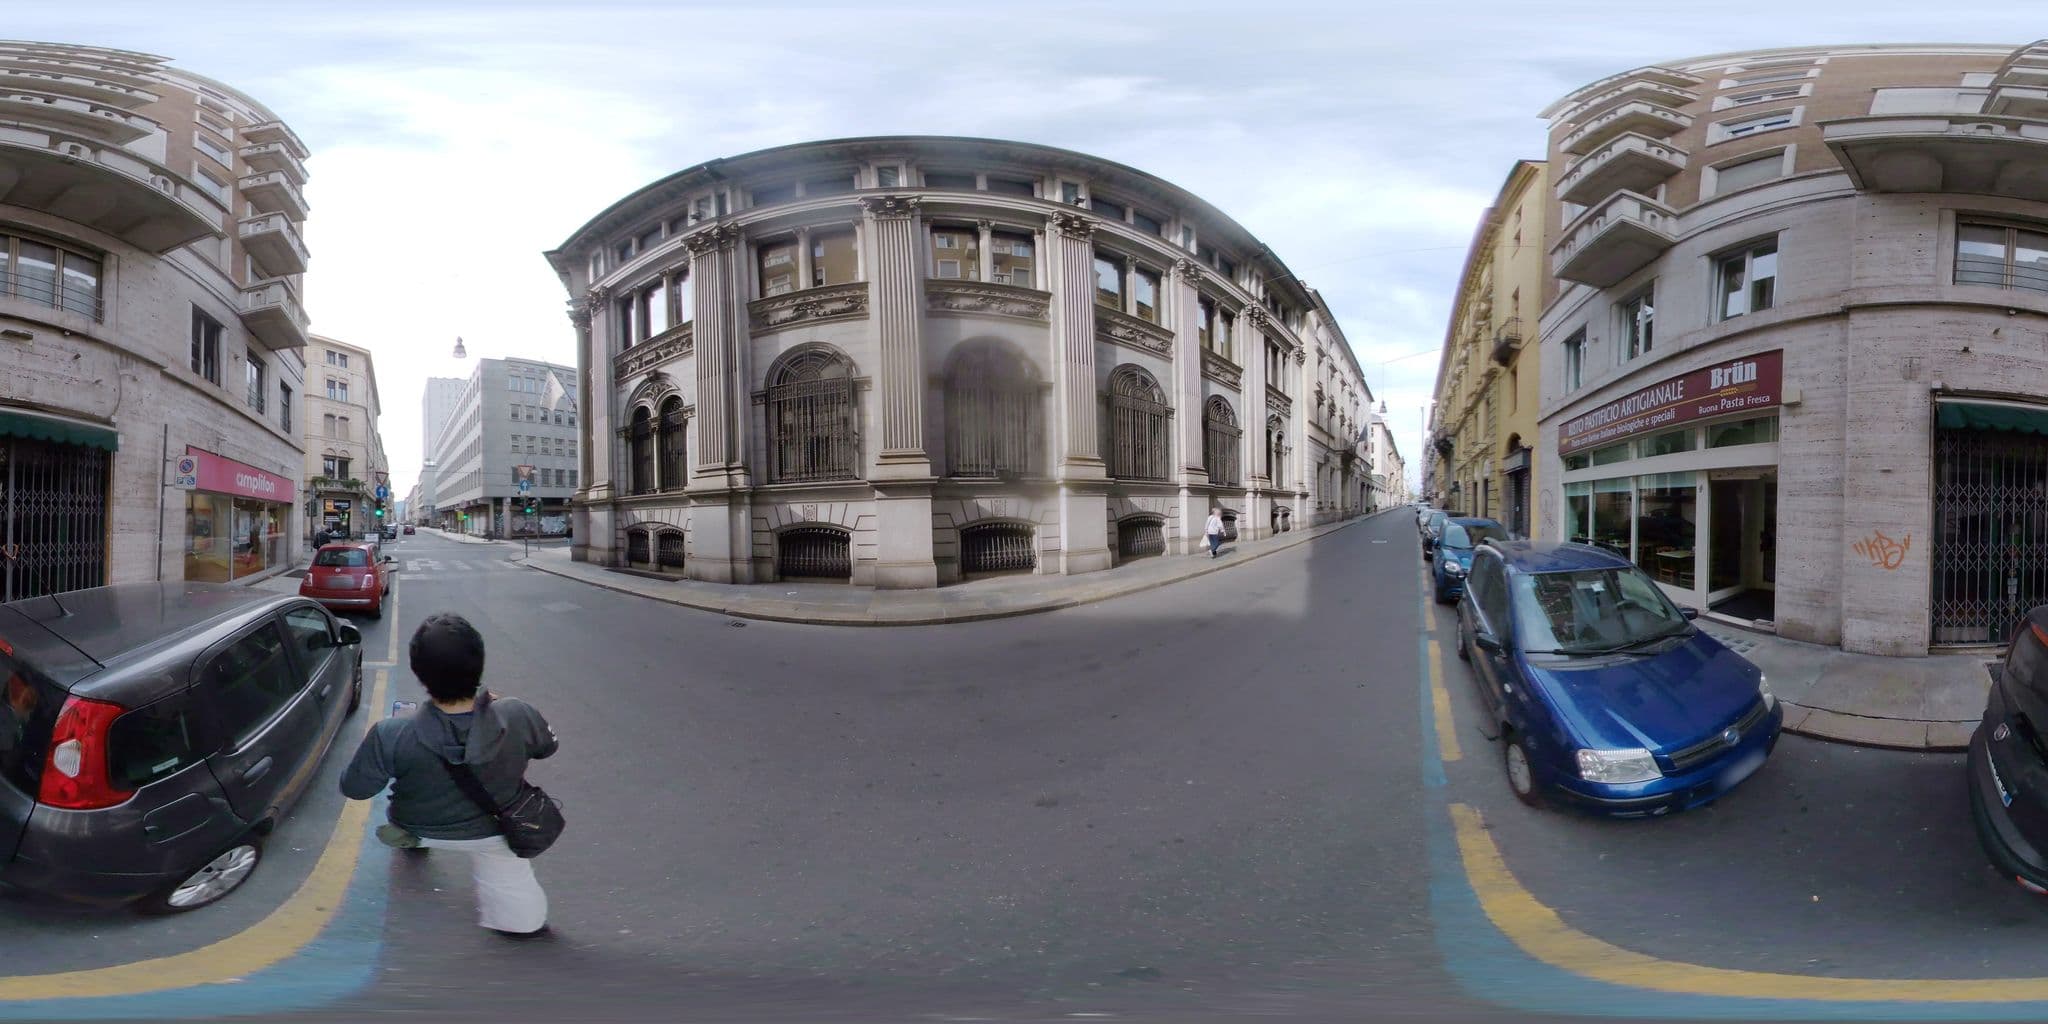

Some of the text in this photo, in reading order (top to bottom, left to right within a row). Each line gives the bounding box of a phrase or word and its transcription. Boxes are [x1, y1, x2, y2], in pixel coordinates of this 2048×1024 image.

[1710, 361, 1757, 390] Brün
[1584, 403, 1620, 431] PASTIFICIO
[1620, 379, 1684, 418] ARTIGIANALE
[1698, 395, 1770, 415] Buona Pasta Fresca
[1616, 420, 1645, 435] biologiche
[1651, 408, 1676, 427] speciali
[236, 472, 275, 494] amplifon
